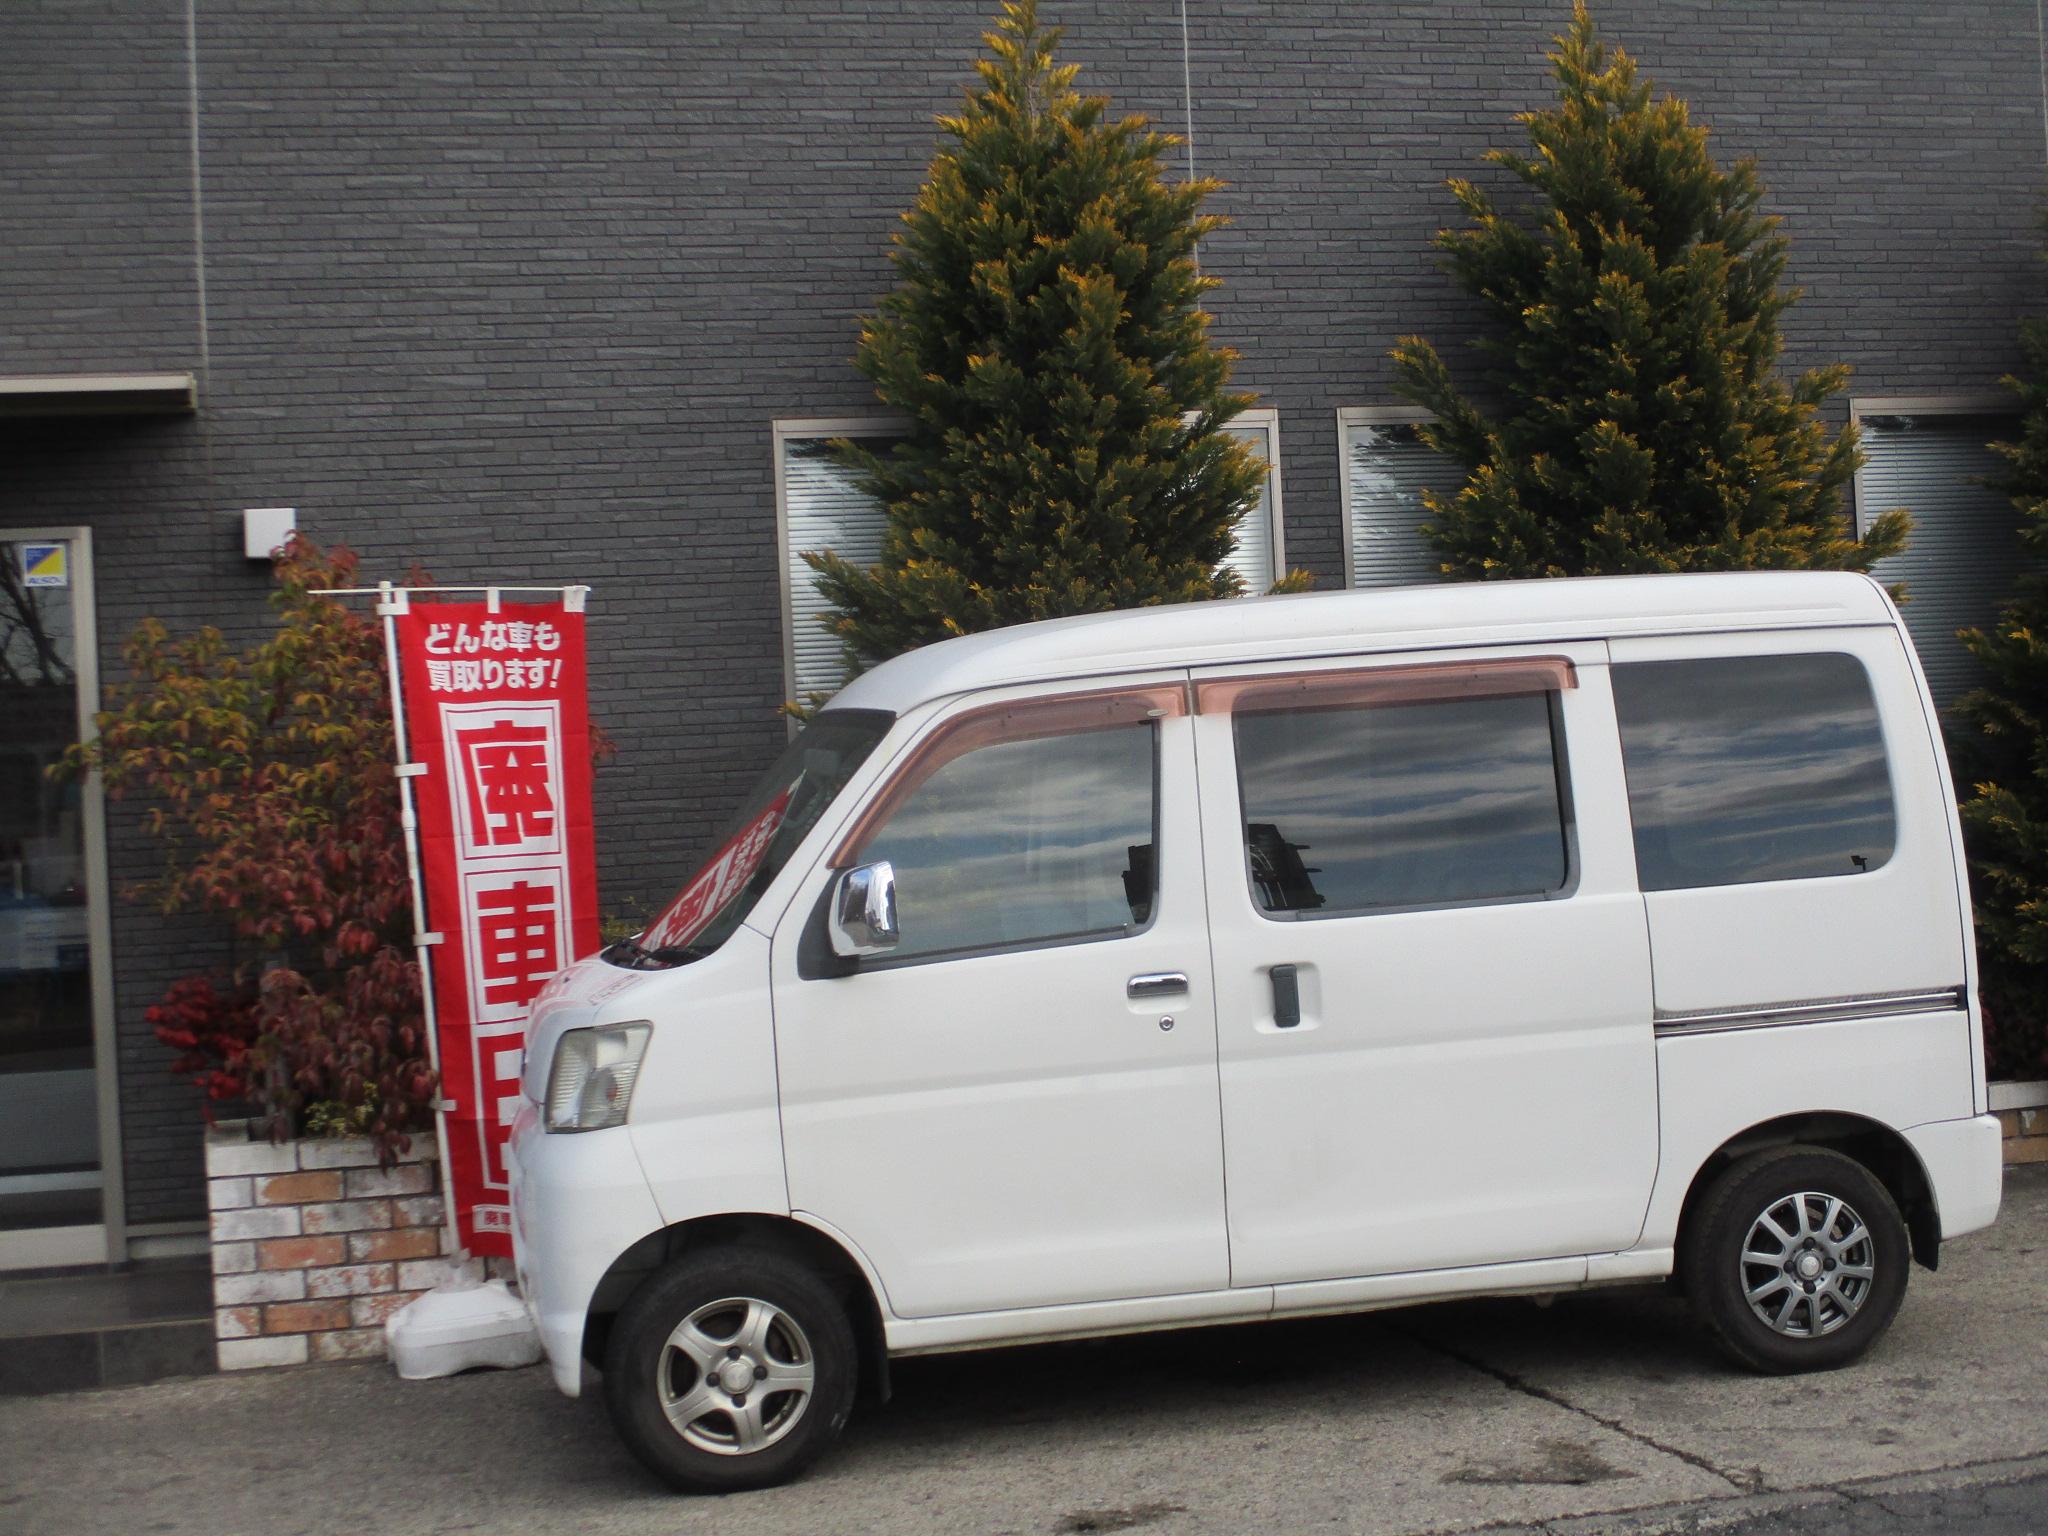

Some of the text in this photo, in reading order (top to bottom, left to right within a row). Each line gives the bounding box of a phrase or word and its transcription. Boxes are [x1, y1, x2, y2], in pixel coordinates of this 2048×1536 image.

[425, 621, 561, 654] どんな車も
[426, 658, 562, 692] 買取ります!
